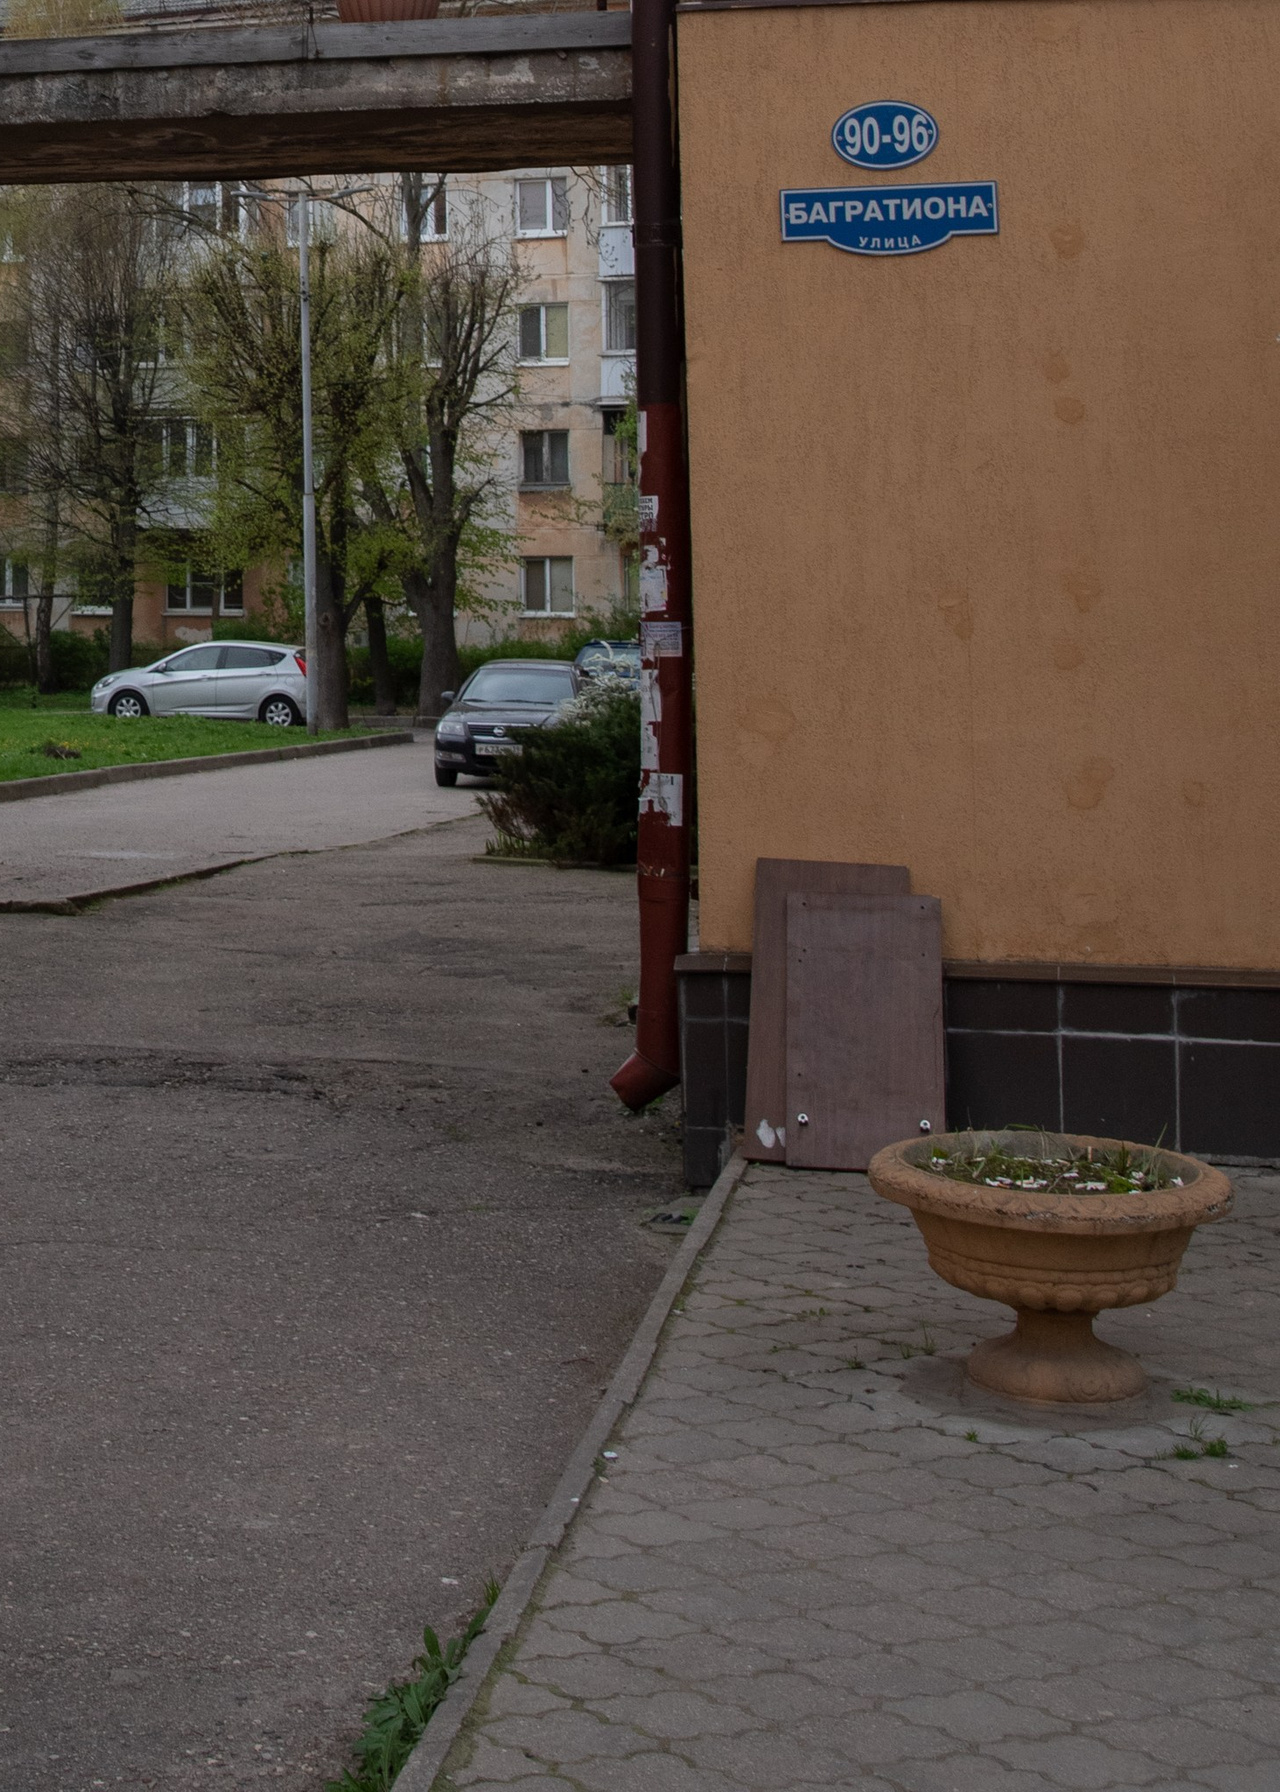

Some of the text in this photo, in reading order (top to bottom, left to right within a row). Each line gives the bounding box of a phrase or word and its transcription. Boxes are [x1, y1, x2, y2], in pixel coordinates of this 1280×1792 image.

[844, 114, 929, 156] 90-96
[789, 195, 989, 225] БАГРАТИОНА
[859, 234, 922, 249] УЛИЦА
